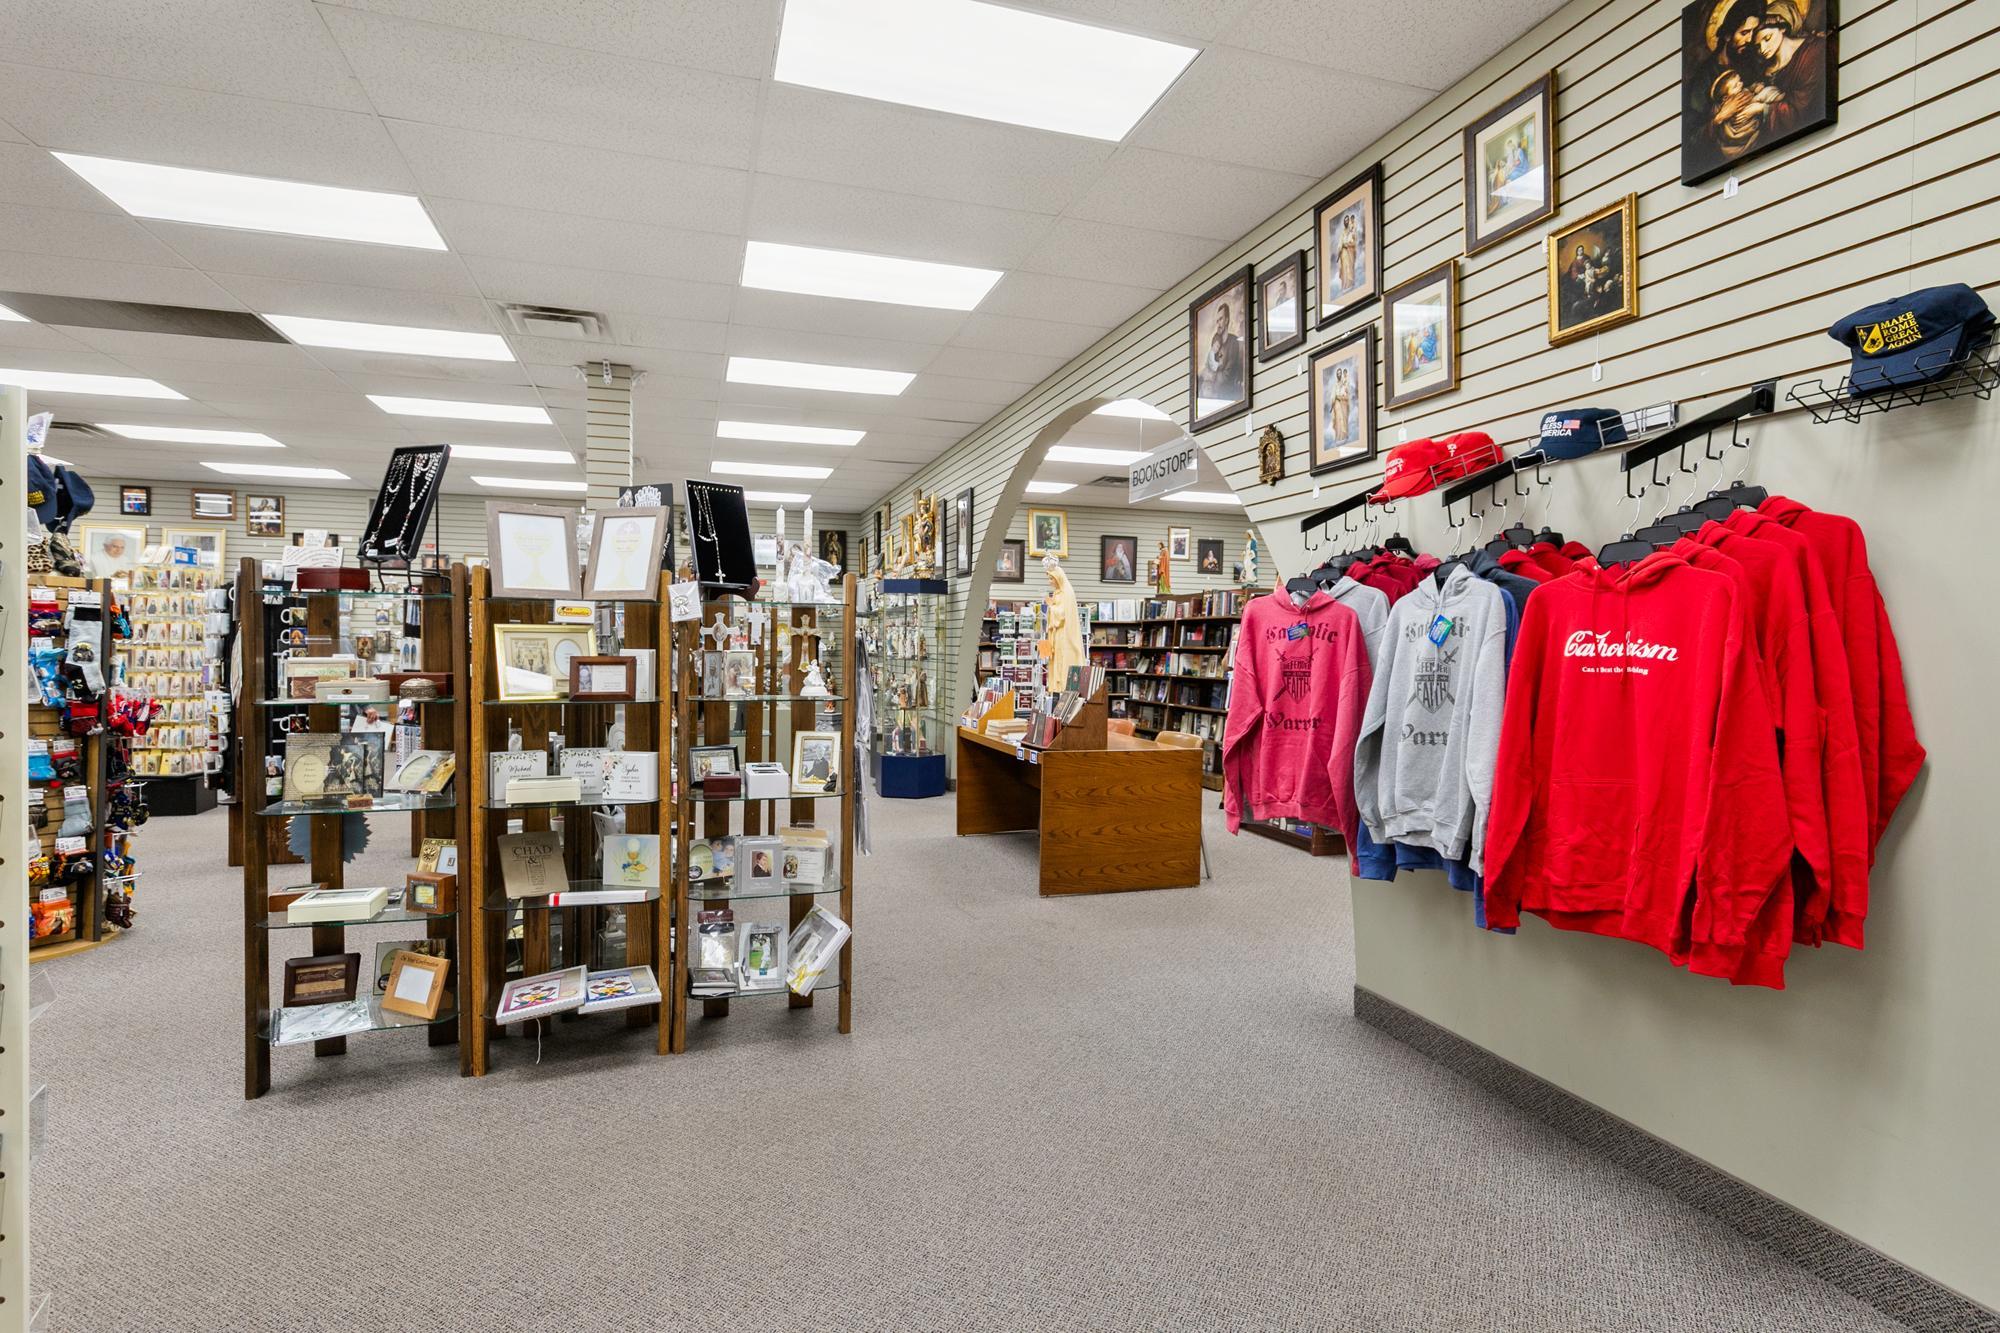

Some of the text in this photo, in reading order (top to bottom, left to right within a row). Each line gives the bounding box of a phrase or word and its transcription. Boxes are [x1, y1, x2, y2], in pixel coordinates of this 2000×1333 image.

[1880, 311, 1914, 330] MAKE
[1882, 318, 1917, 337] ROME
[1885, 325, 1919, 342] GREAT
[1888, 332, 1922, 350] AGAIN
[1541, 421, 1563, 430] BLESS
[1545, 414, 1558, 424] GOD
[1541, 428, 1572, 438] AMERICA
[1132, 448, 1194, 487] BOOKSTORE
[1266, 620, 1338, 644] Caolic
[1406, 615, 1471, 643] Calic
[1564, 630, 1679, 662] Caholism
[1286, 677, 1310, 698] FAITH
[1416, 682, 1448, 708] FAITH
[512, 845, 552, 857] CHAD
